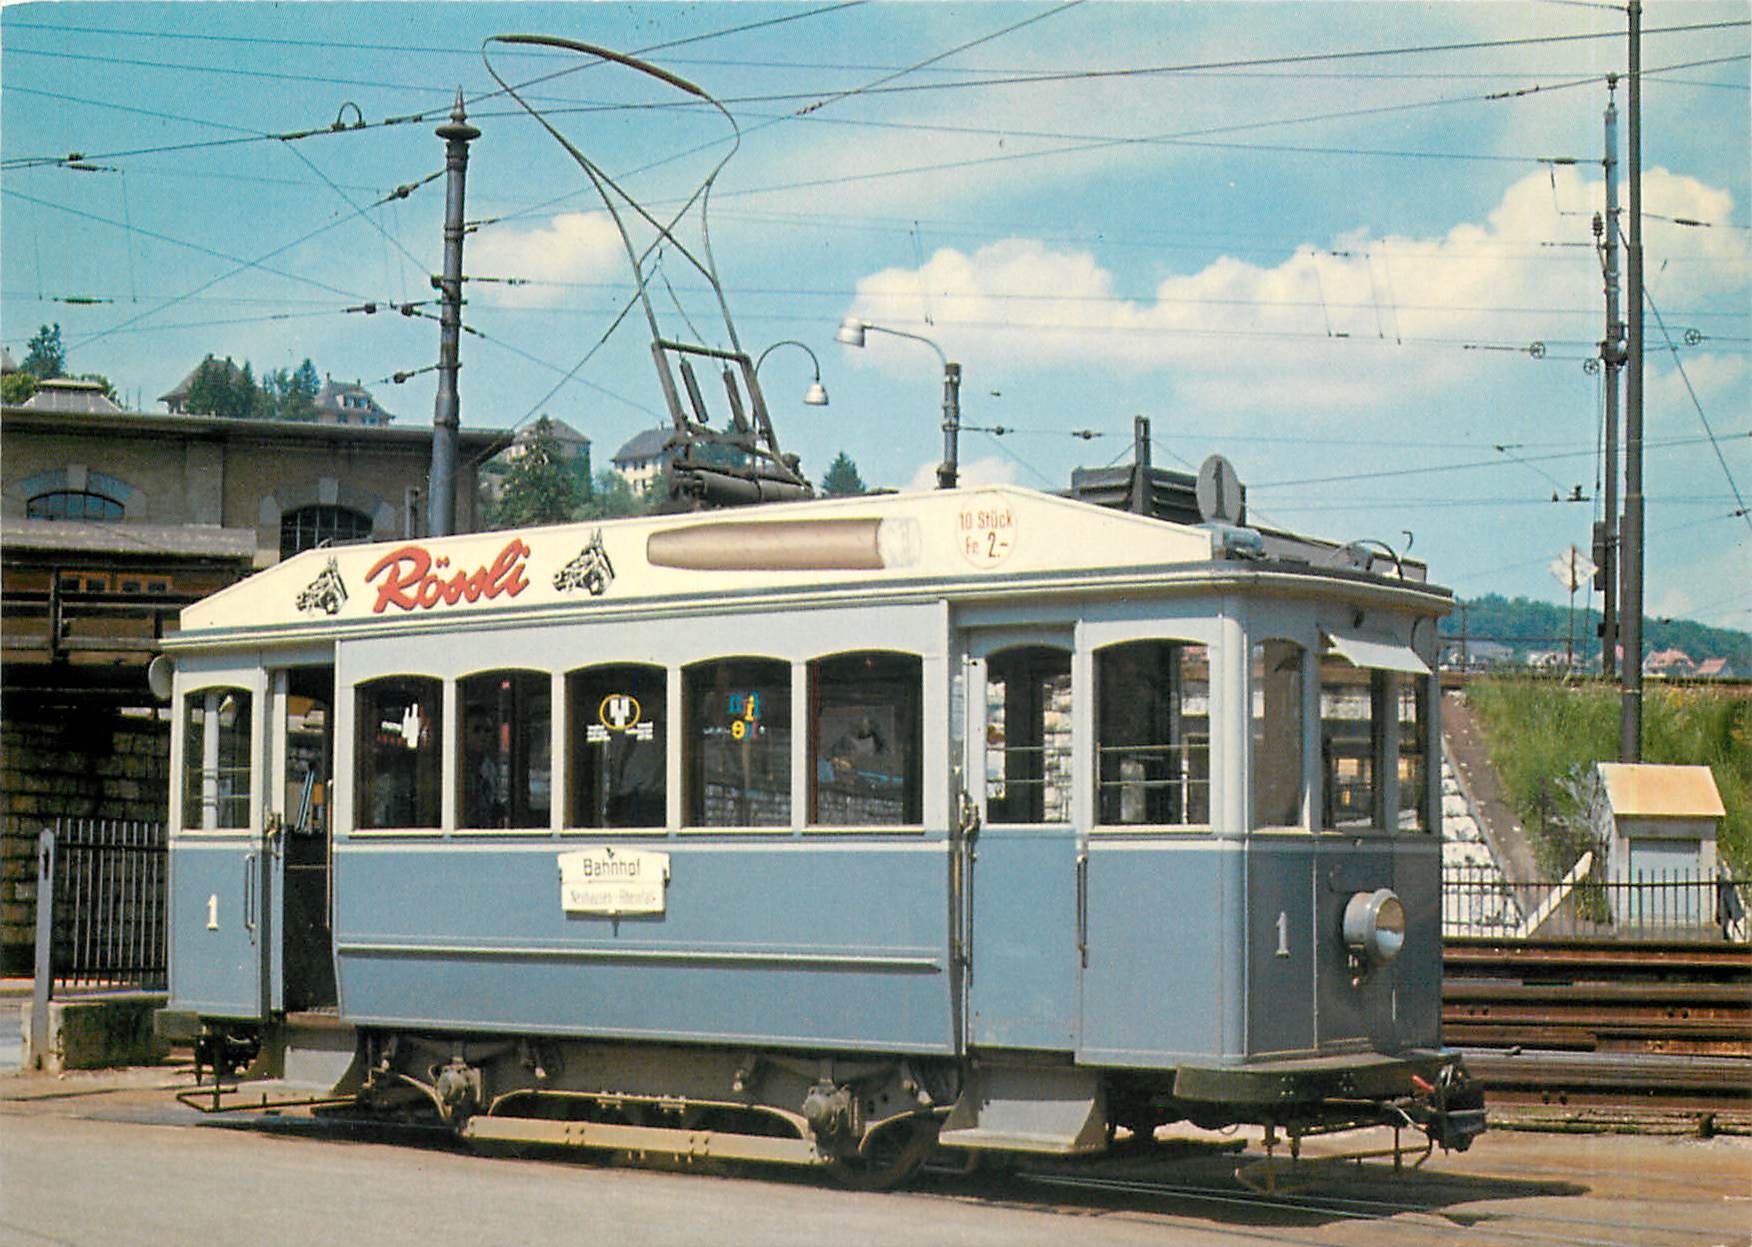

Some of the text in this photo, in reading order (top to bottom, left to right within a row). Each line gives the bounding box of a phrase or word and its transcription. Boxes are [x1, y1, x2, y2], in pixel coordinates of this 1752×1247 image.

[1211, 459, 1232, 519] 1
[959, 509, 1013, 530] 10 Stück
[364, 537, 531, 614] Rössli
[583, 857, 641, 877] Bahnhof
[207, 893, 219, 929] 1
[1275, 911, 1292, 959] 1
